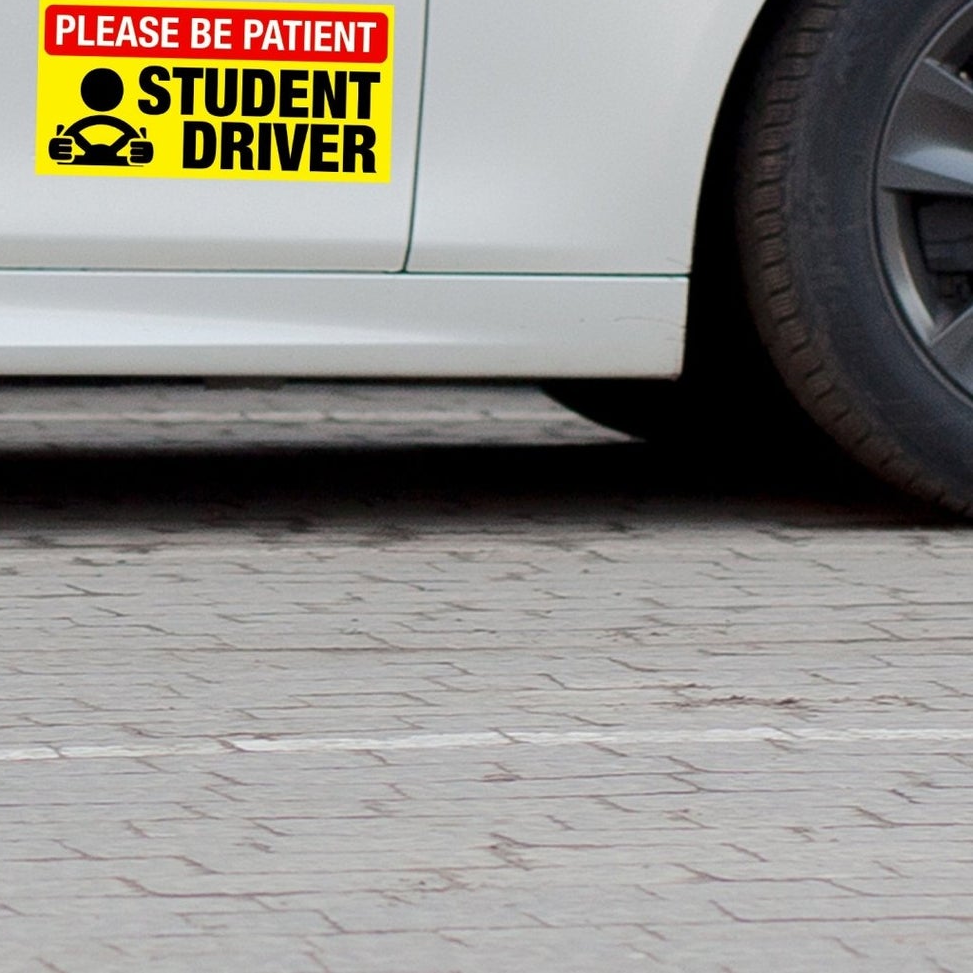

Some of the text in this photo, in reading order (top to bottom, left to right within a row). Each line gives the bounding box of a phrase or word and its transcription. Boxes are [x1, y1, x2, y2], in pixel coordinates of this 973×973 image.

[55, 14, 377, 53] PLEASE BE PATIENT
[138, 65, 381, 119] STUDENT
[182, 121, 377, 173] DRIVER
